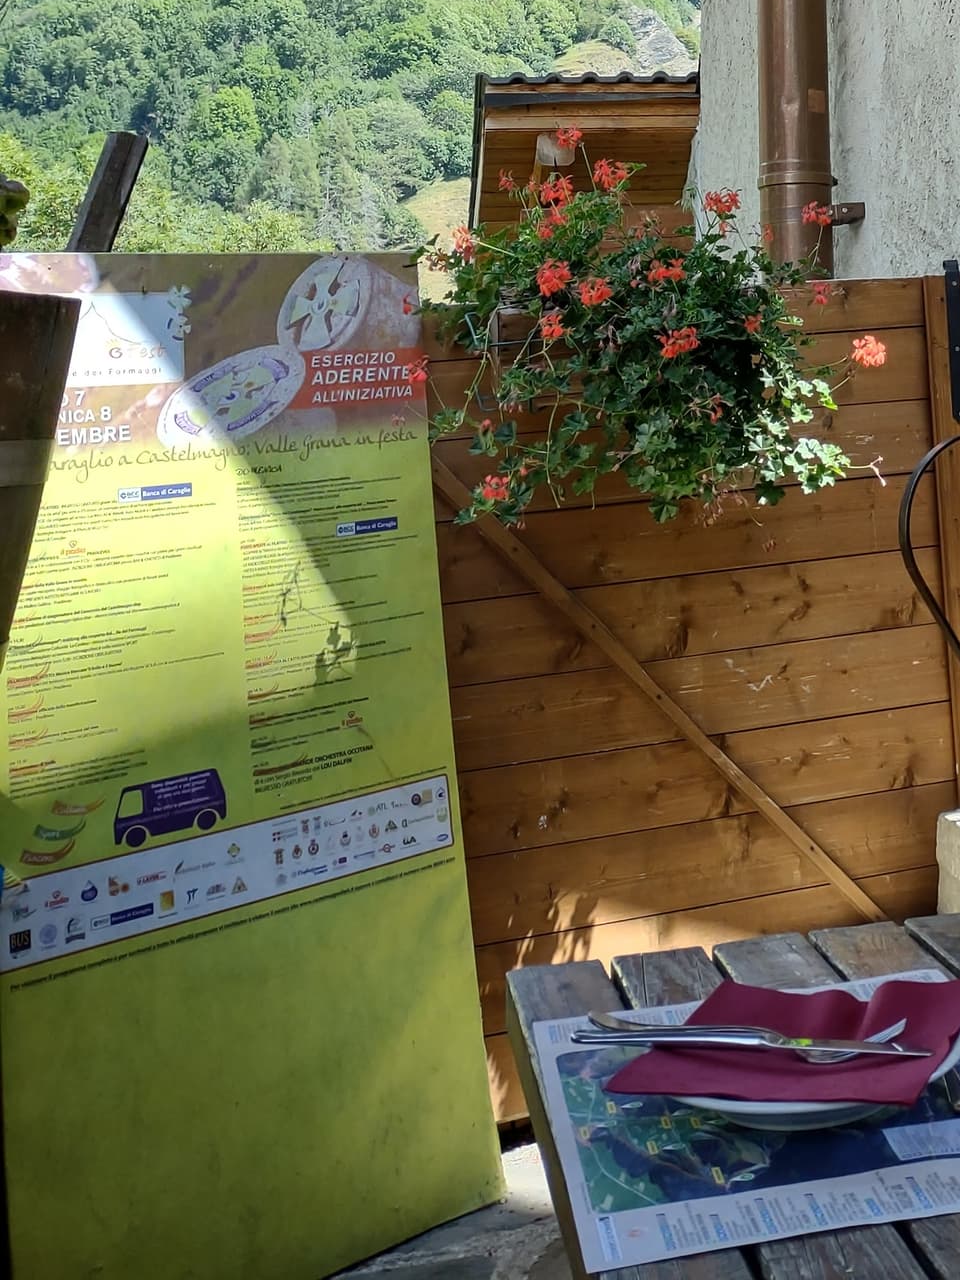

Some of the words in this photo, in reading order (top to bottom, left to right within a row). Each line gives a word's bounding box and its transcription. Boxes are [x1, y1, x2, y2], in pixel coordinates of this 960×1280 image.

[310, 351, 396, 368] ESERCIZIO
[72, 390, 87, 407] 7
[311, 384, 413, 404] ALL'INIZIATIVA
[58, 407, 96, 424] NICA
[99, 405, 113, 421] 8
[56, 424, 132, 447] EMBRE
[49, 448, 115, 483] araglio
[254, 435, 298, 455] Valle
[299, 434, 350, 462] Grana
[353, 433, 374, 446] in
[376, 427, 418, 450] festa
[10, 931, 30, 949] BUS
